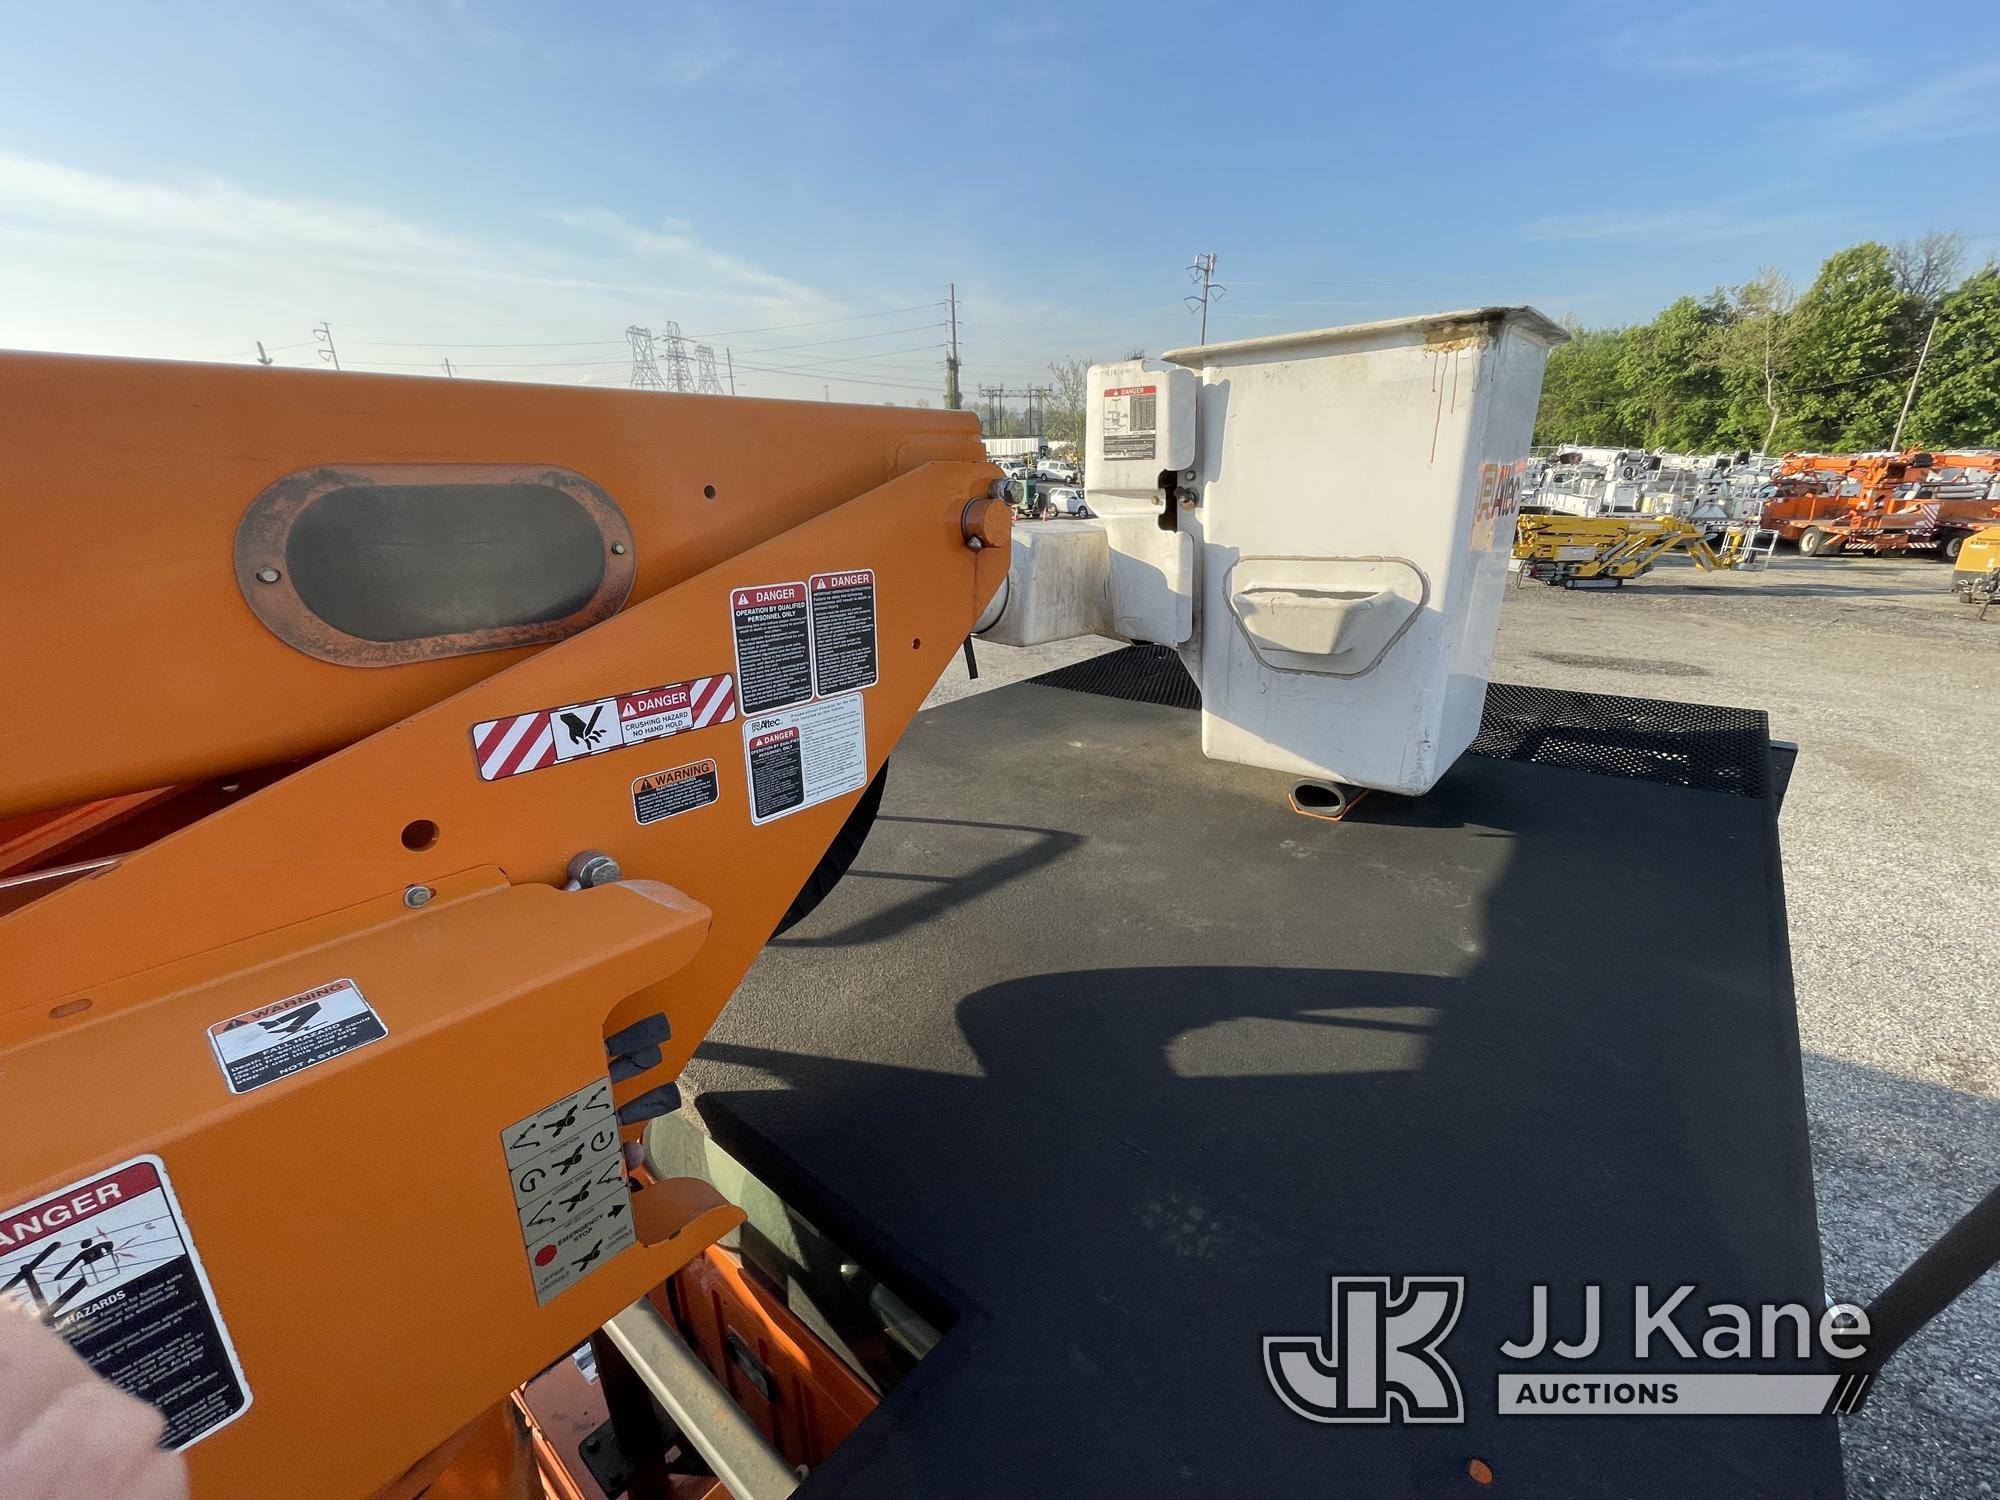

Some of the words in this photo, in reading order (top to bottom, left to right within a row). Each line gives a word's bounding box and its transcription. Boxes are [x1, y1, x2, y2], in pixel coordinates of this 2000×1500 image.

[1491, 465, 1520, 518] Altec
[832, 574, 869, 586] DANGER
[756, 588, 794, 602] DANGER
[736, 607, 768, 616] OPERATION
[777, 602, 804, 610] QUALIFIED
[747, 613, 780, 622] PERSONNEL
[638, 692, 686, 712] DANGER
[626, 718, 660, 731] CRUSHING
[662, 712, 688, 722] HAZARD
[645, 726, 664, 734] HAND
[665, 720, 682, 730] HOLD
[760, 718, 780, 730] Altec
[764, 730, 794, 744] DANGER
[655, 763, 710, 786] WARNING
[252, 983, 343, 1020] WARNING
[230, 1059, 260, 1071] Death
[277, 1039, 312, 1054] serious
[315, 1028, 340, 1039] injury
[341, 1016, 370, 1028] could
[262, 1043, 291, 1055] FALL
[294, 1023, 339, 1042] HAZARD
[233, 1062, 262, 1076] result
[265, 1052, 288, 1063] from
[291, 1043, 313, 1053] slips
[317, 1034, 334, 1043] and
[252, 1064, 268, 1073] not
[271, 1057, 289, 1065] use
[292, 1048, 311, 1057] this
[314, 1040, 332, 1049] area
[279, 1061, 303, 1074] NOT
[317, 1045, 347, 1058] STEP
[550, 1135, 579, 1154] ROTATION
[557, 1213, 602, 1245] EMERGENCY
[573, 1226, 592, 1242] STOP
[608, 1225, 627, 1239] LOWER
[66, 1290, 125, 1323] HAZARDS
